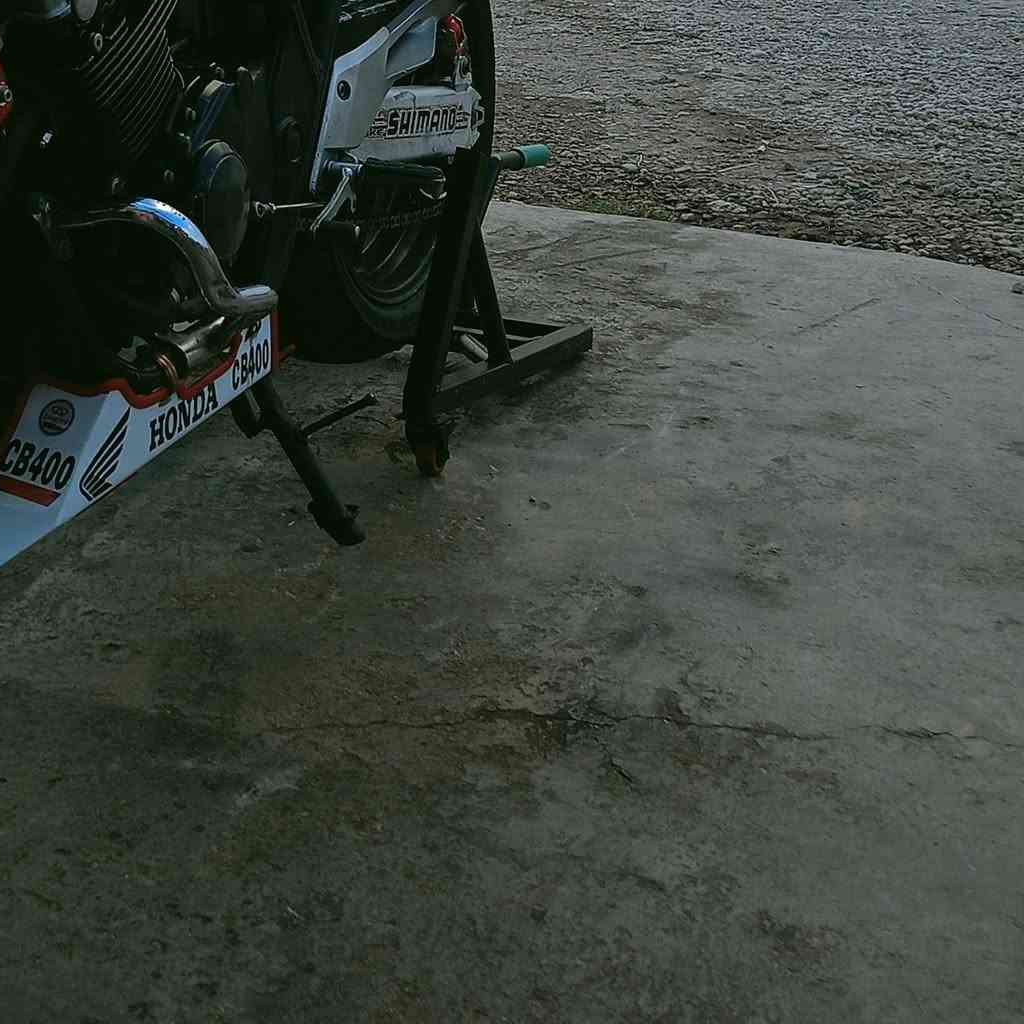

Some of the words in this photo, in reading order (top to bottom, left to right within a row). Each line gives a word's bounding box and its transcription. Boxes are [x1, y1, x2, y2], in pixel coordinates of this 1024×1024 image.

[387, 109, 457, 137] SHIMANO
[149, 383, 219, 451] HONDA
[232, 338, 270, 391] CB400
[0, 438, 76, 490] CB400
